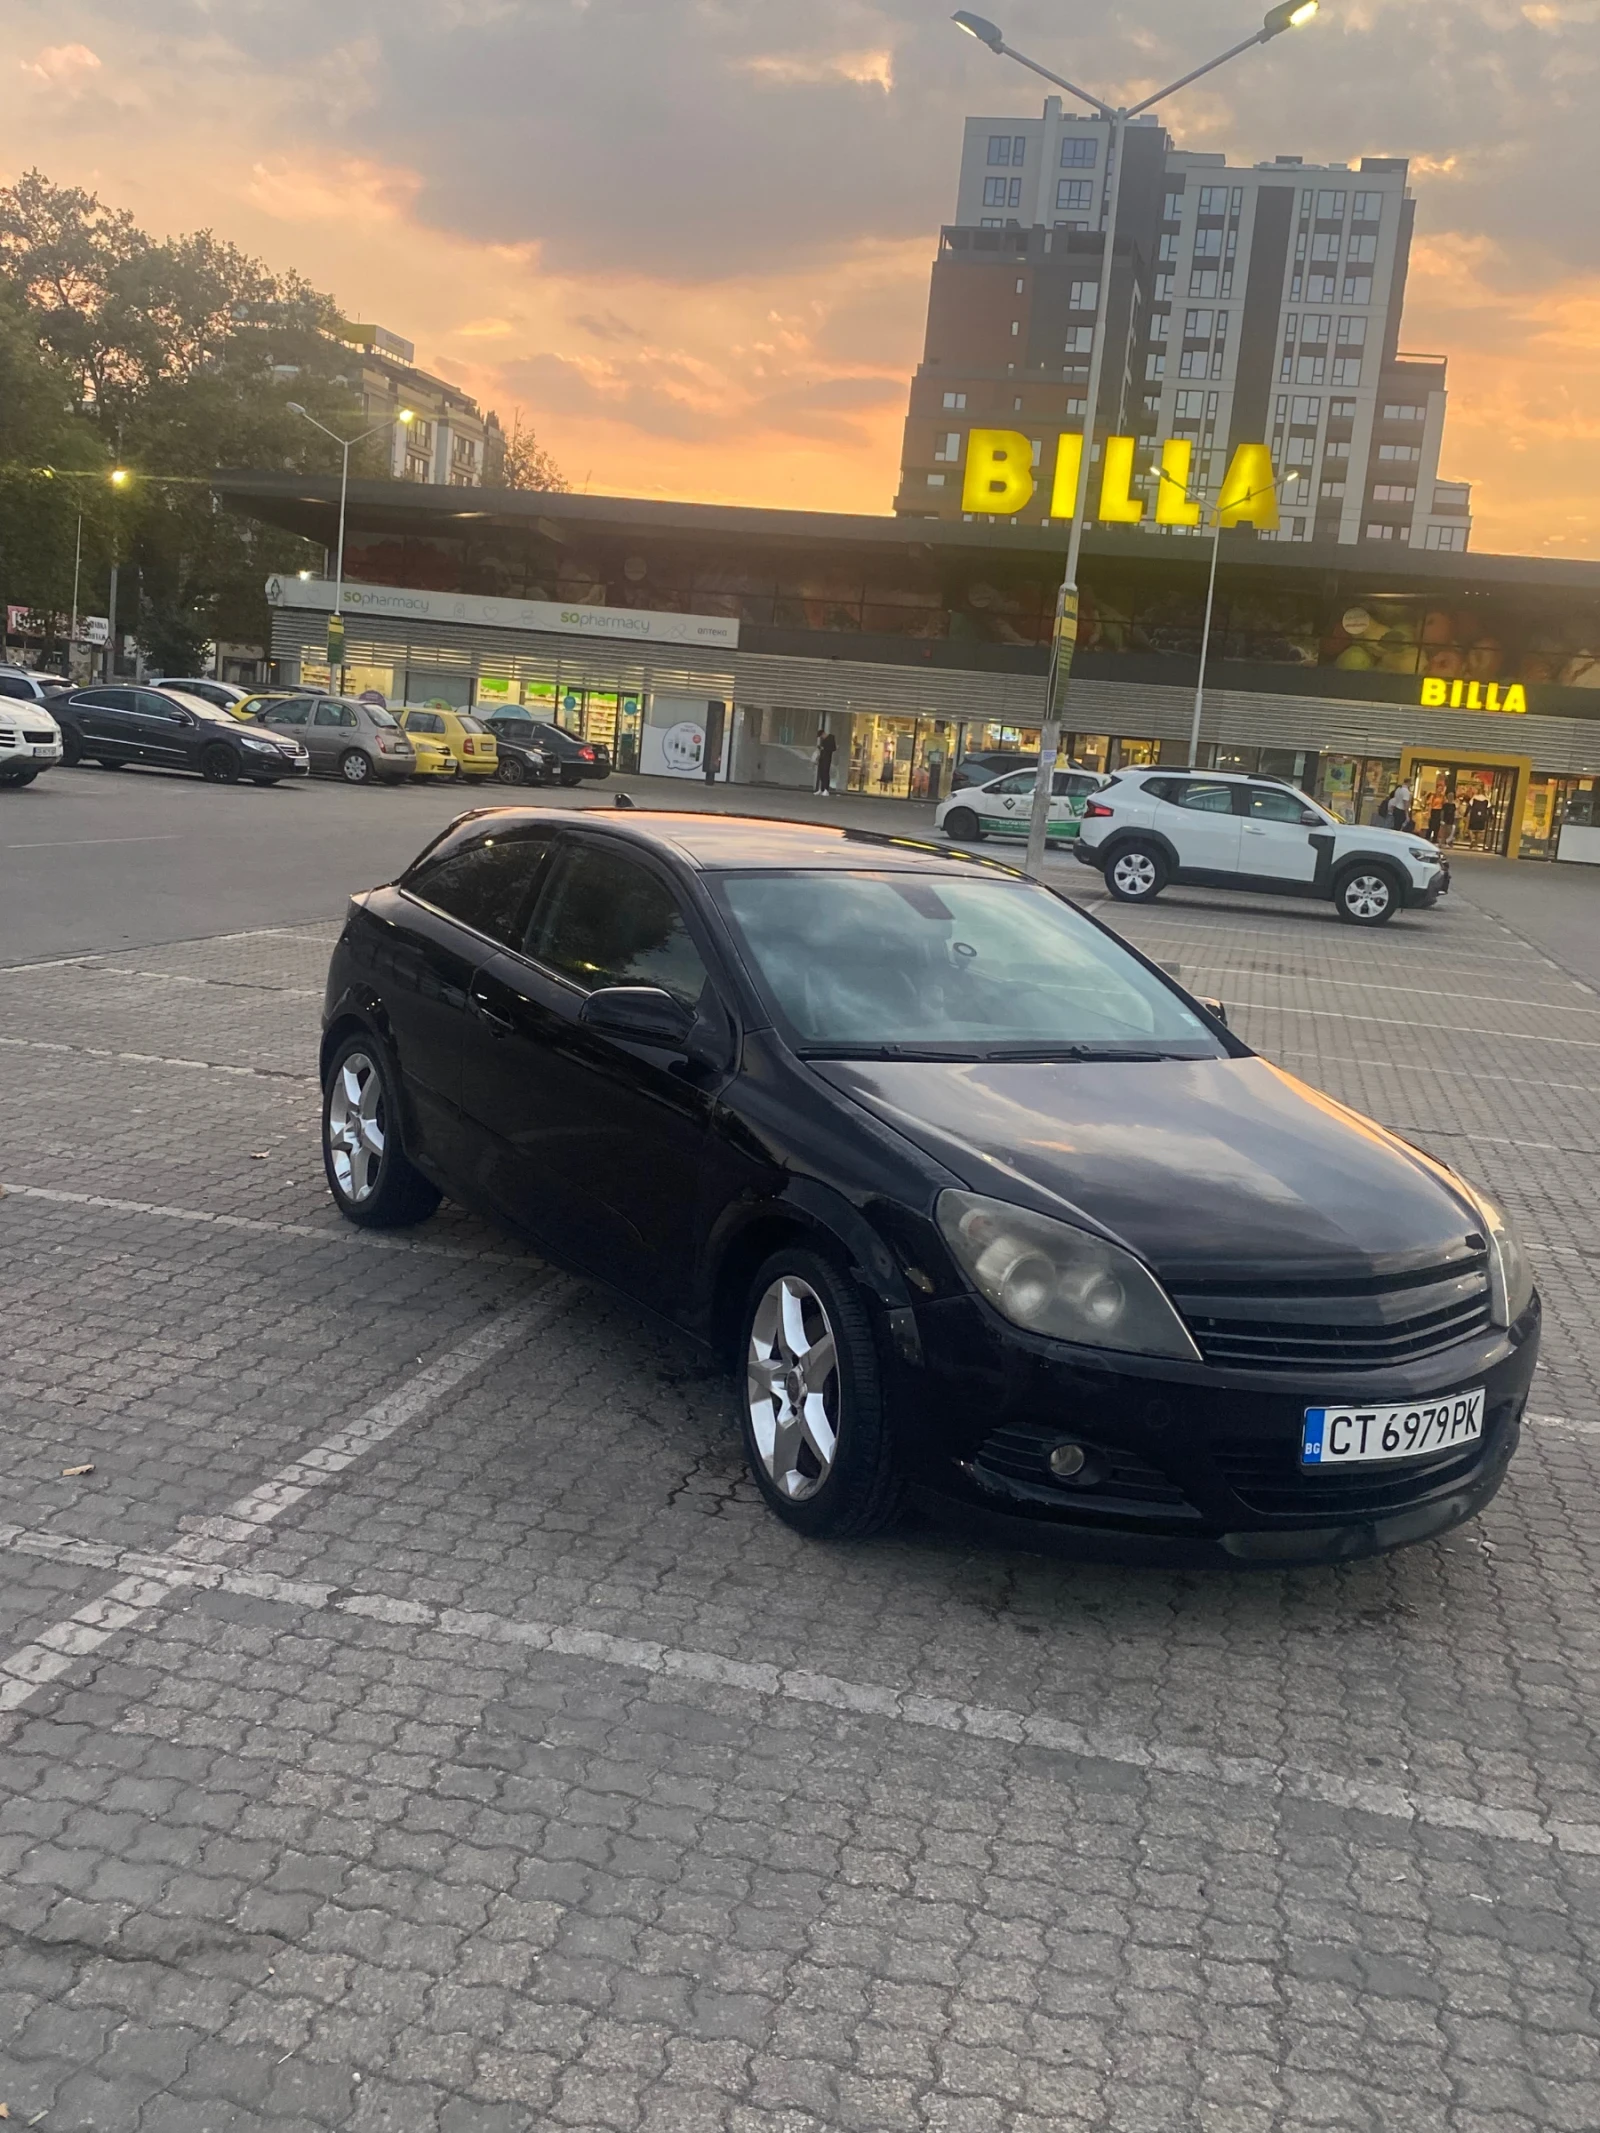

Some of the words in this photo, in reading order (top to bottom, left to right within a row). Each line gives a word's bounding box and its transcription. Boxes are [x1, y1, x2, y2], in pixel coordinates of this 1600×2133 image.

[961, 428, 1280, 530] BILLA
[343, 591, 430, 613] sopharmacy
[560, 611, 650, 634] sopharmacy
[1421, 677, 1527, 713] BILLA
[1304, 1442, 1321, 1455] BG
